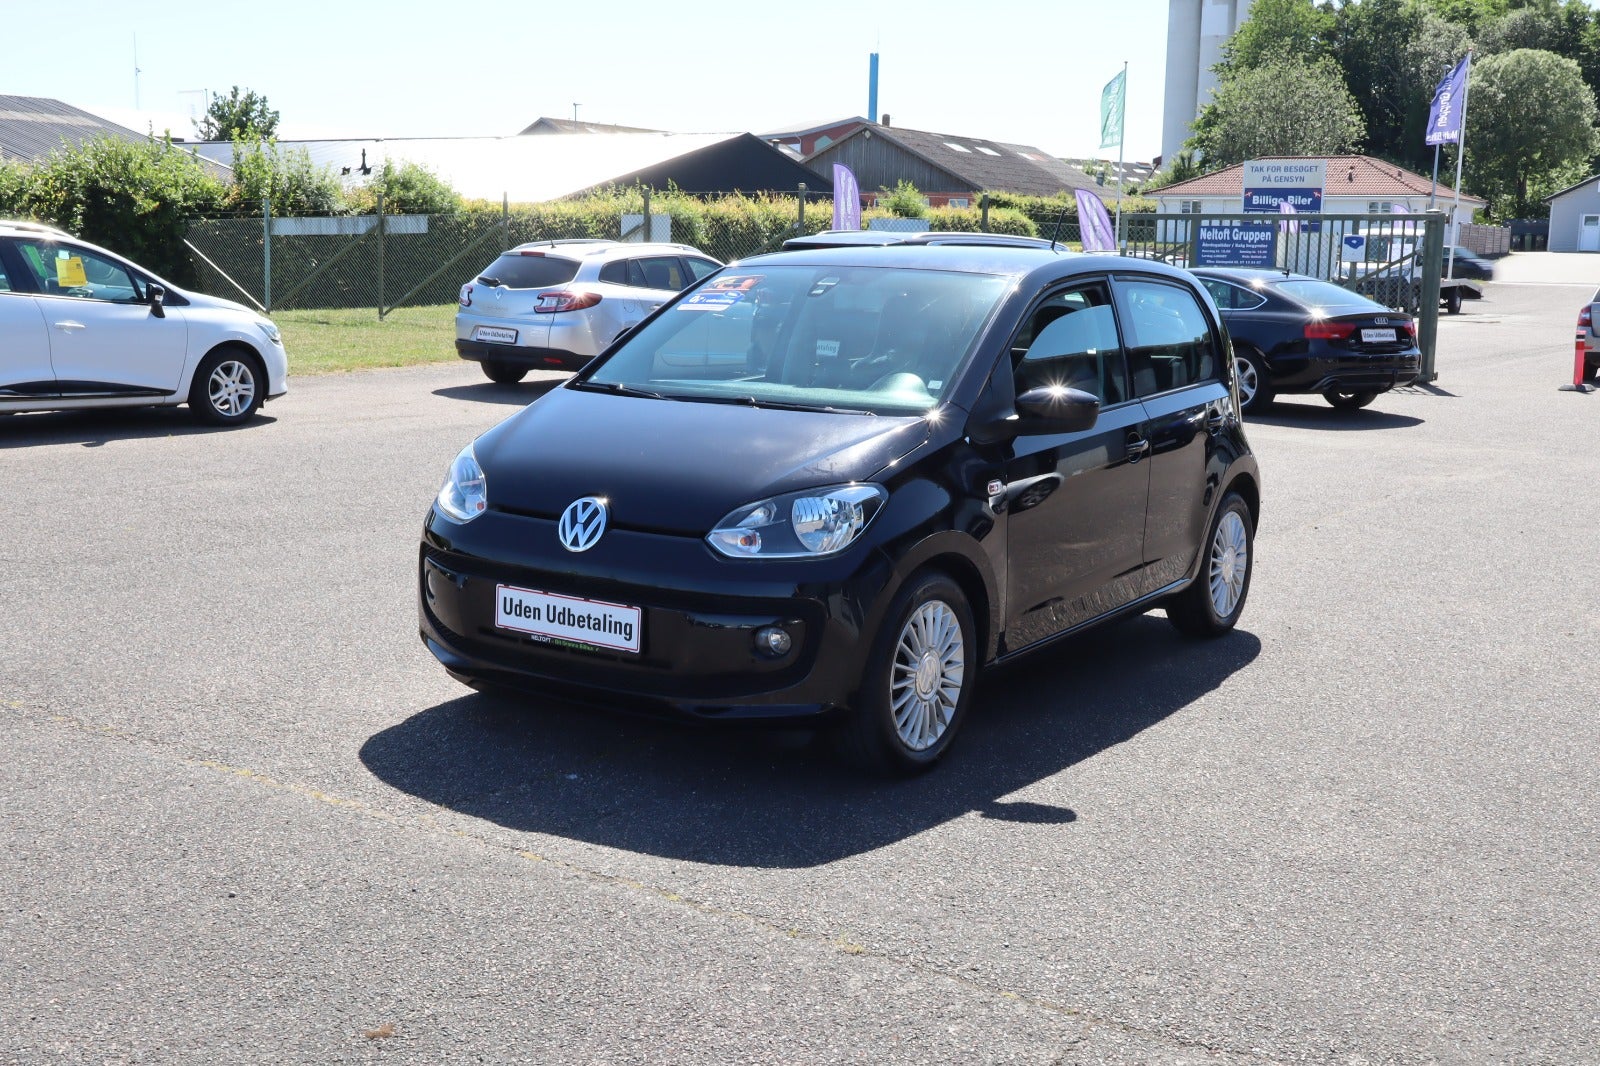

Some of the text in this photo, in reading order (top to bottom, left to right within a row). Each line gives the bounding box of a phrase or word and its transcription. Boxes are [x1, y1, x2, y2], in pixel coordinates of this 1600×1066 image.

[1250, 165, 1319, 173] TAK FOR BESØGET
[1261, 175, 1305, 183] PÅ GENSYN
[1252, 195, 1313, 207] Billige Biler
[1200, 227, 1272, 243] Neltoft Gruppen
[503, 596, 633, 642] Uden Udbetaling
